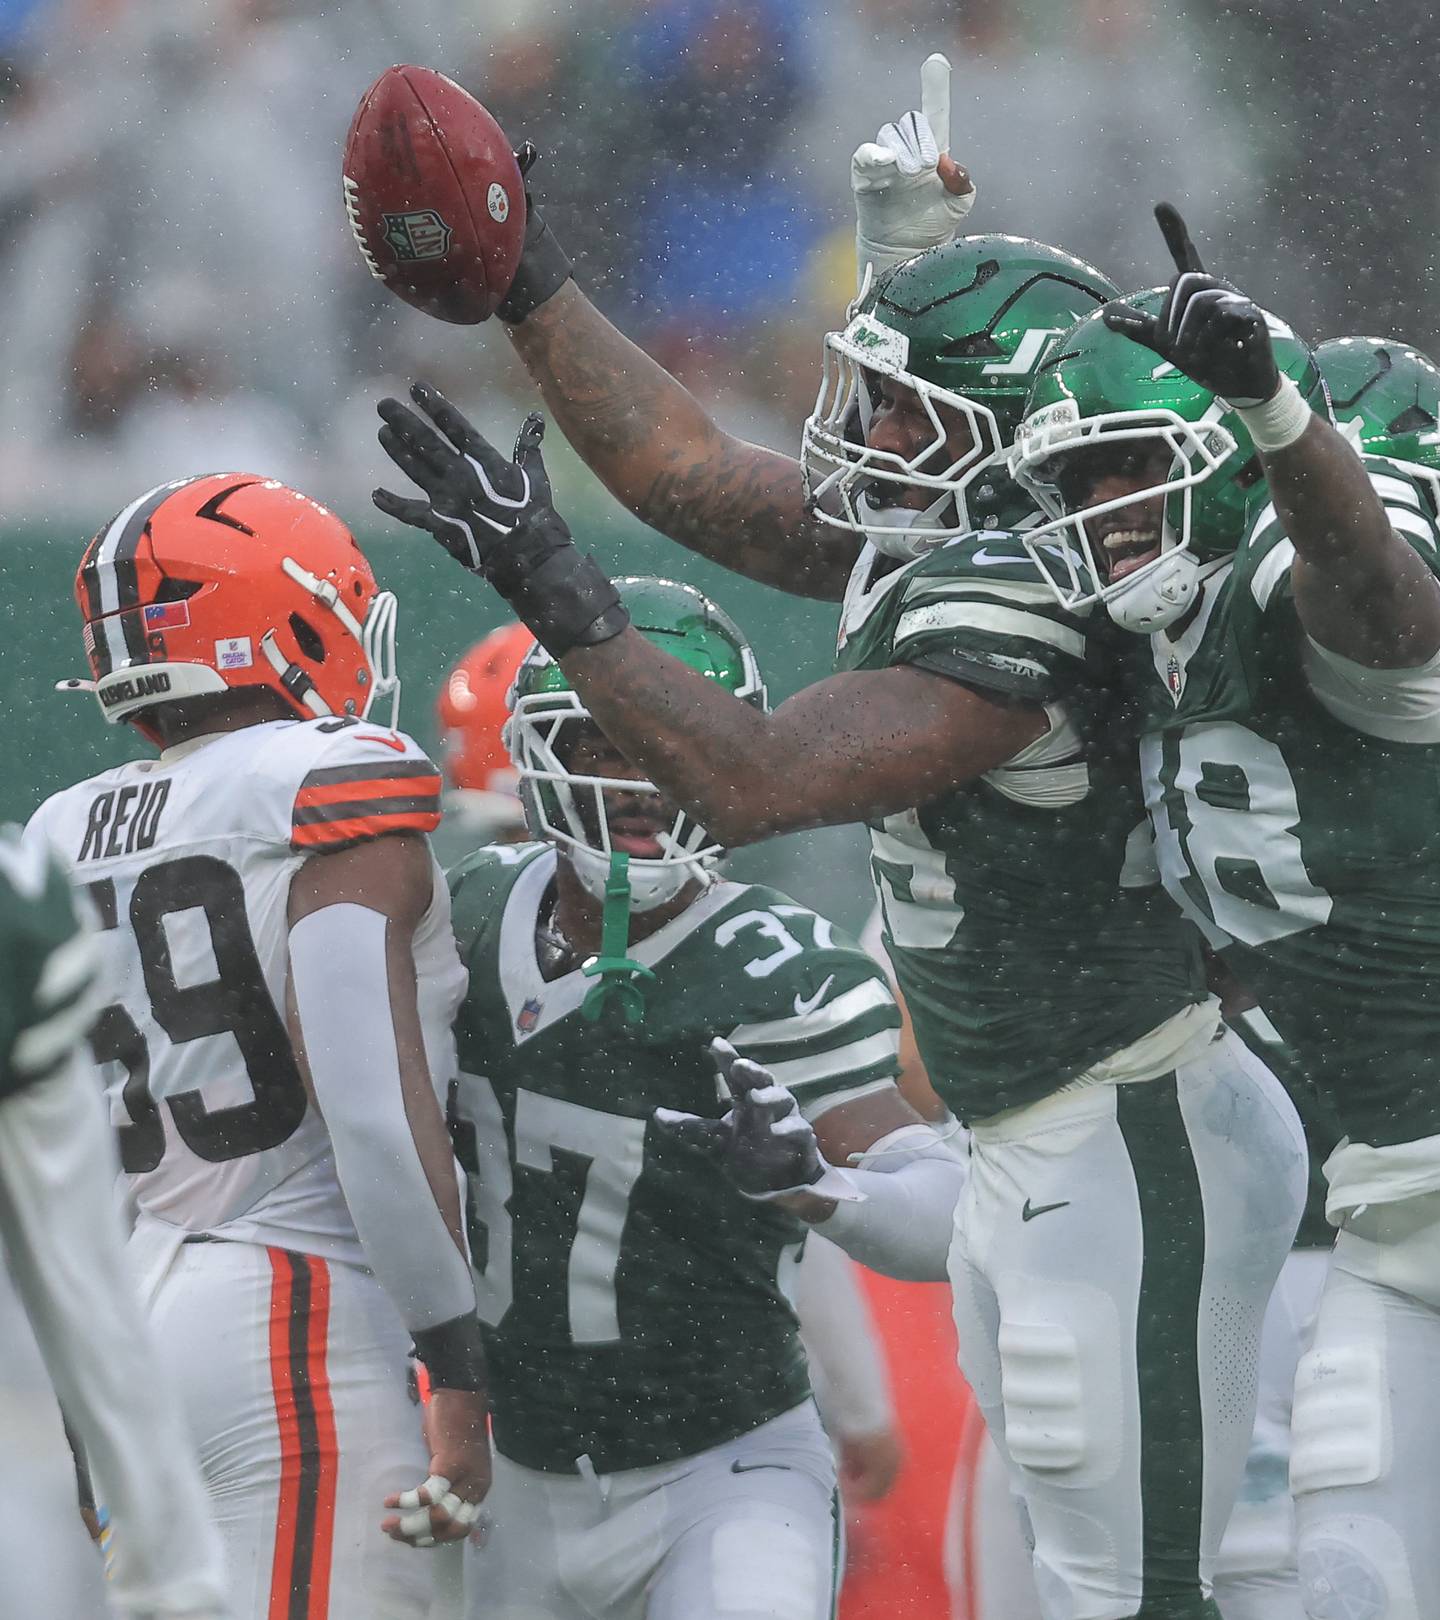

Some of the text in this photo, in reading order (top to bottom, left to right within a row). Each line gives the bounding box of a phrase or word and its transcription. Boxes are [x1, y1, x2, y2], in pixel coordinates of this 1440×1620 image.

[407, 214, 443, 257] NFL
[98, 671, 171, 707] LEVELAND
[78, 779, 171, 862] REID
[715, 904, 837, 978] 37
[454, 1071, 647, 1343] 37
